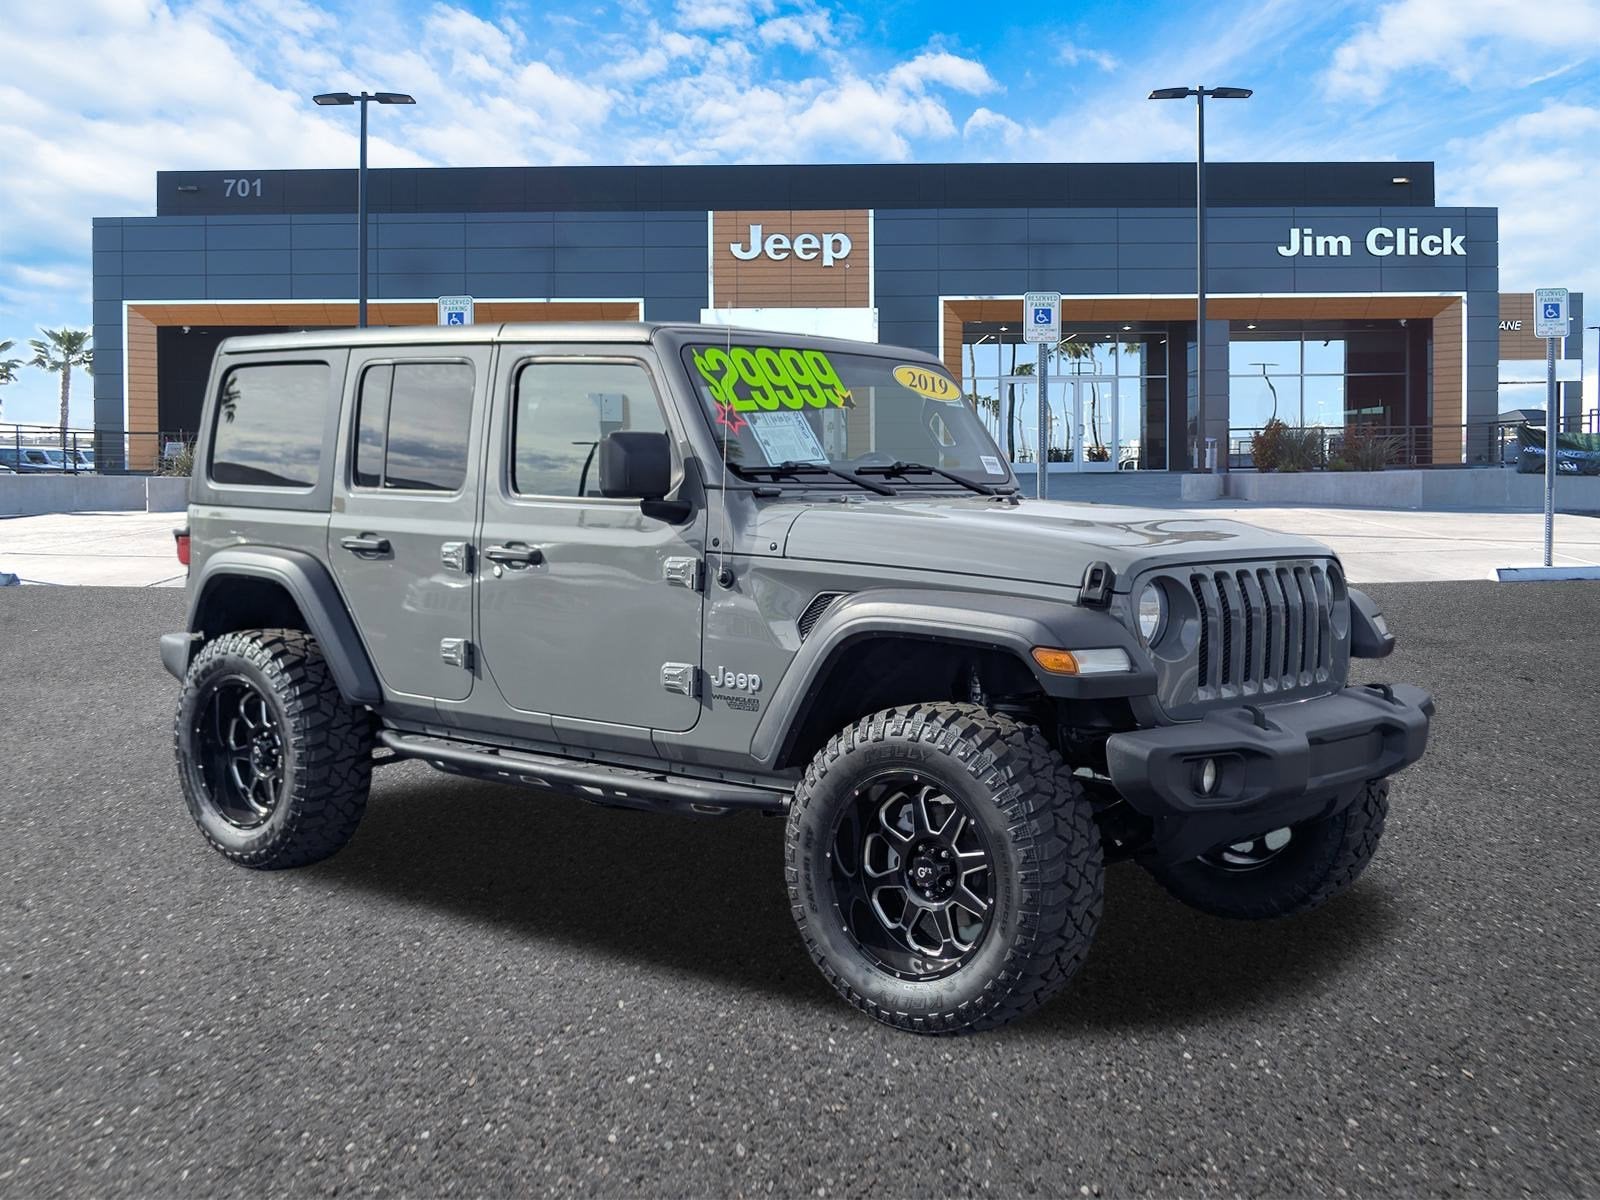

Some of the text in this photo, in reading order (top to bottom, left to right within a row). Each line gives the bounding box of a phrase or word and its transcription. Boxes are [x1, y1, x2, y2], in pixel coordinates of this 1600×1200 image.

[223, 178, 262, 197] 701
[729, 223, 852, 267] Jeep
[1277, 227, 1467, 257] Jim Click
[691, 347, 848, 411] $29999
[907, 371, 949, 395] 2019
[710, 665, 761, 694] Jeep
